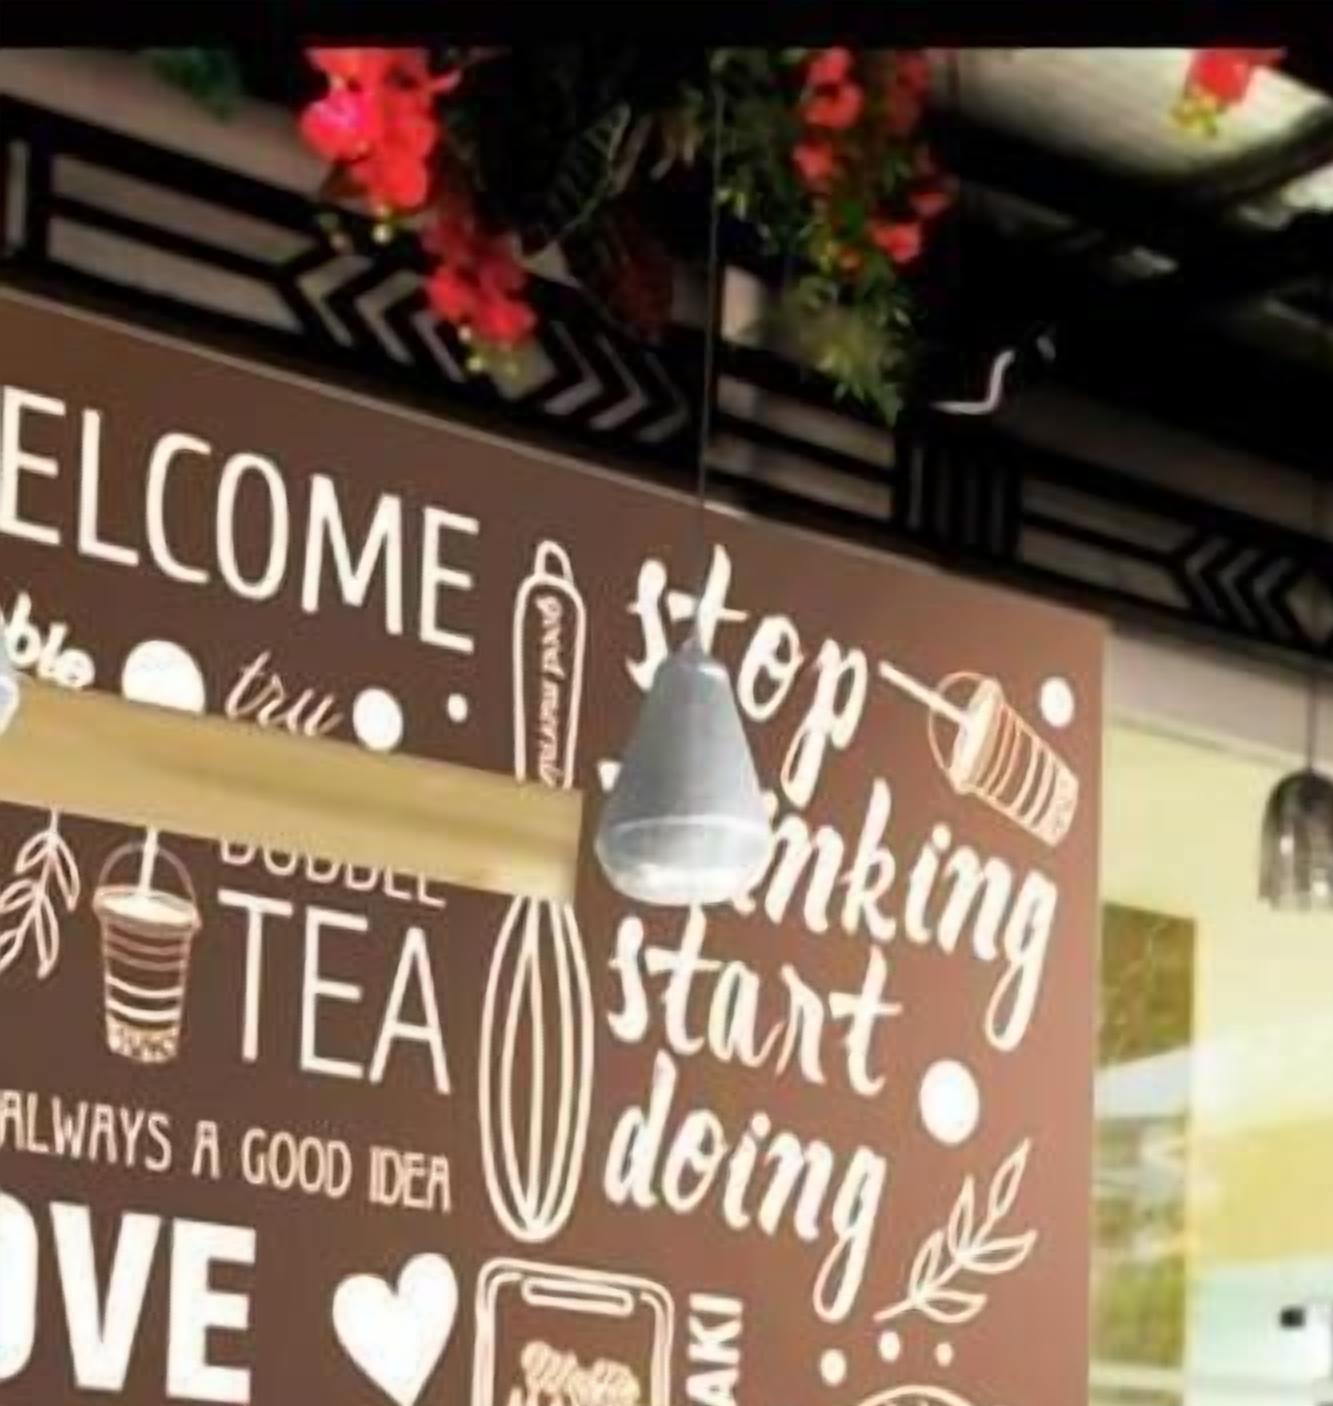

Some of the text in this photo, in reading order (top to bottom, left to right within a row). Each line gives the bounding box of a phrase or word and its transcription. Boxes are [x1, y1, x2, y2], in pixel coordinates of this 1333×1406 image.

[0, 385, 479, 653] ELCOME
[626, 544, 868, 808] stop
[218, 889, 451, 1095] TEA
[598, 758, 1058, 1053] nking
[607, 905, 902, 1096] start
[0, 1089, 451, 1213] ALWAYS A GOOD IDEA
[603, 1051, 887, 1323] doing
